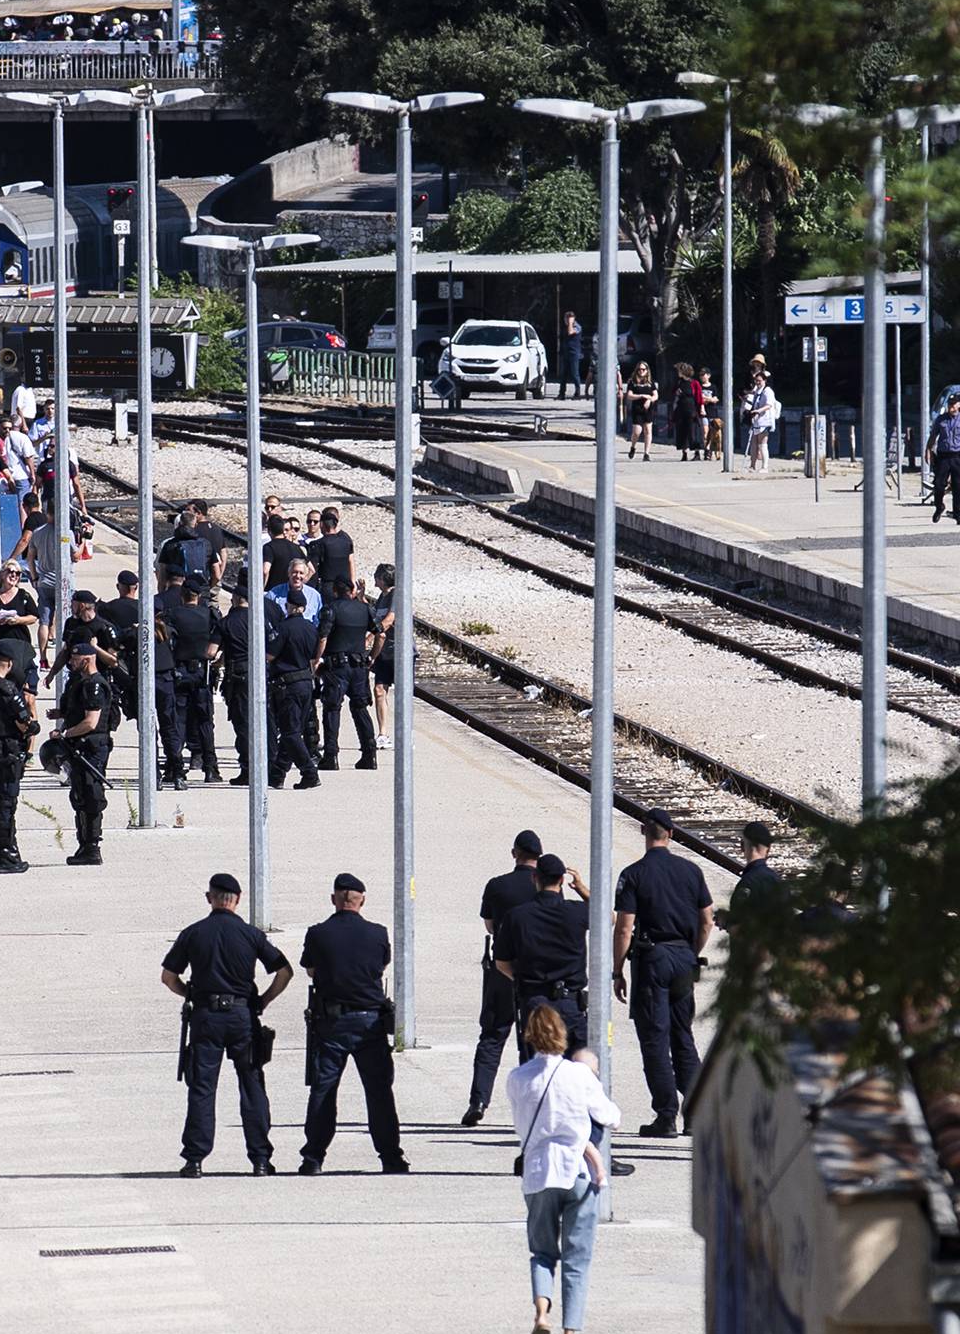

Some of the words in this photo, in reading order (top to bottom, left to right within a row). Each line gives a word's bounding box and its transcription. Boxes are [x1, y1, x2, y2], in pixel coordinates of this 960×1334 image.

[115, 223, 128, 231] G3
[819, 303, 827, 314] 4
[851, 300, 861, 315] 3
[884, 301, 894, 314] 5
[34, 354, 41, 364] 2
[35, 365, 42, 376] 3
